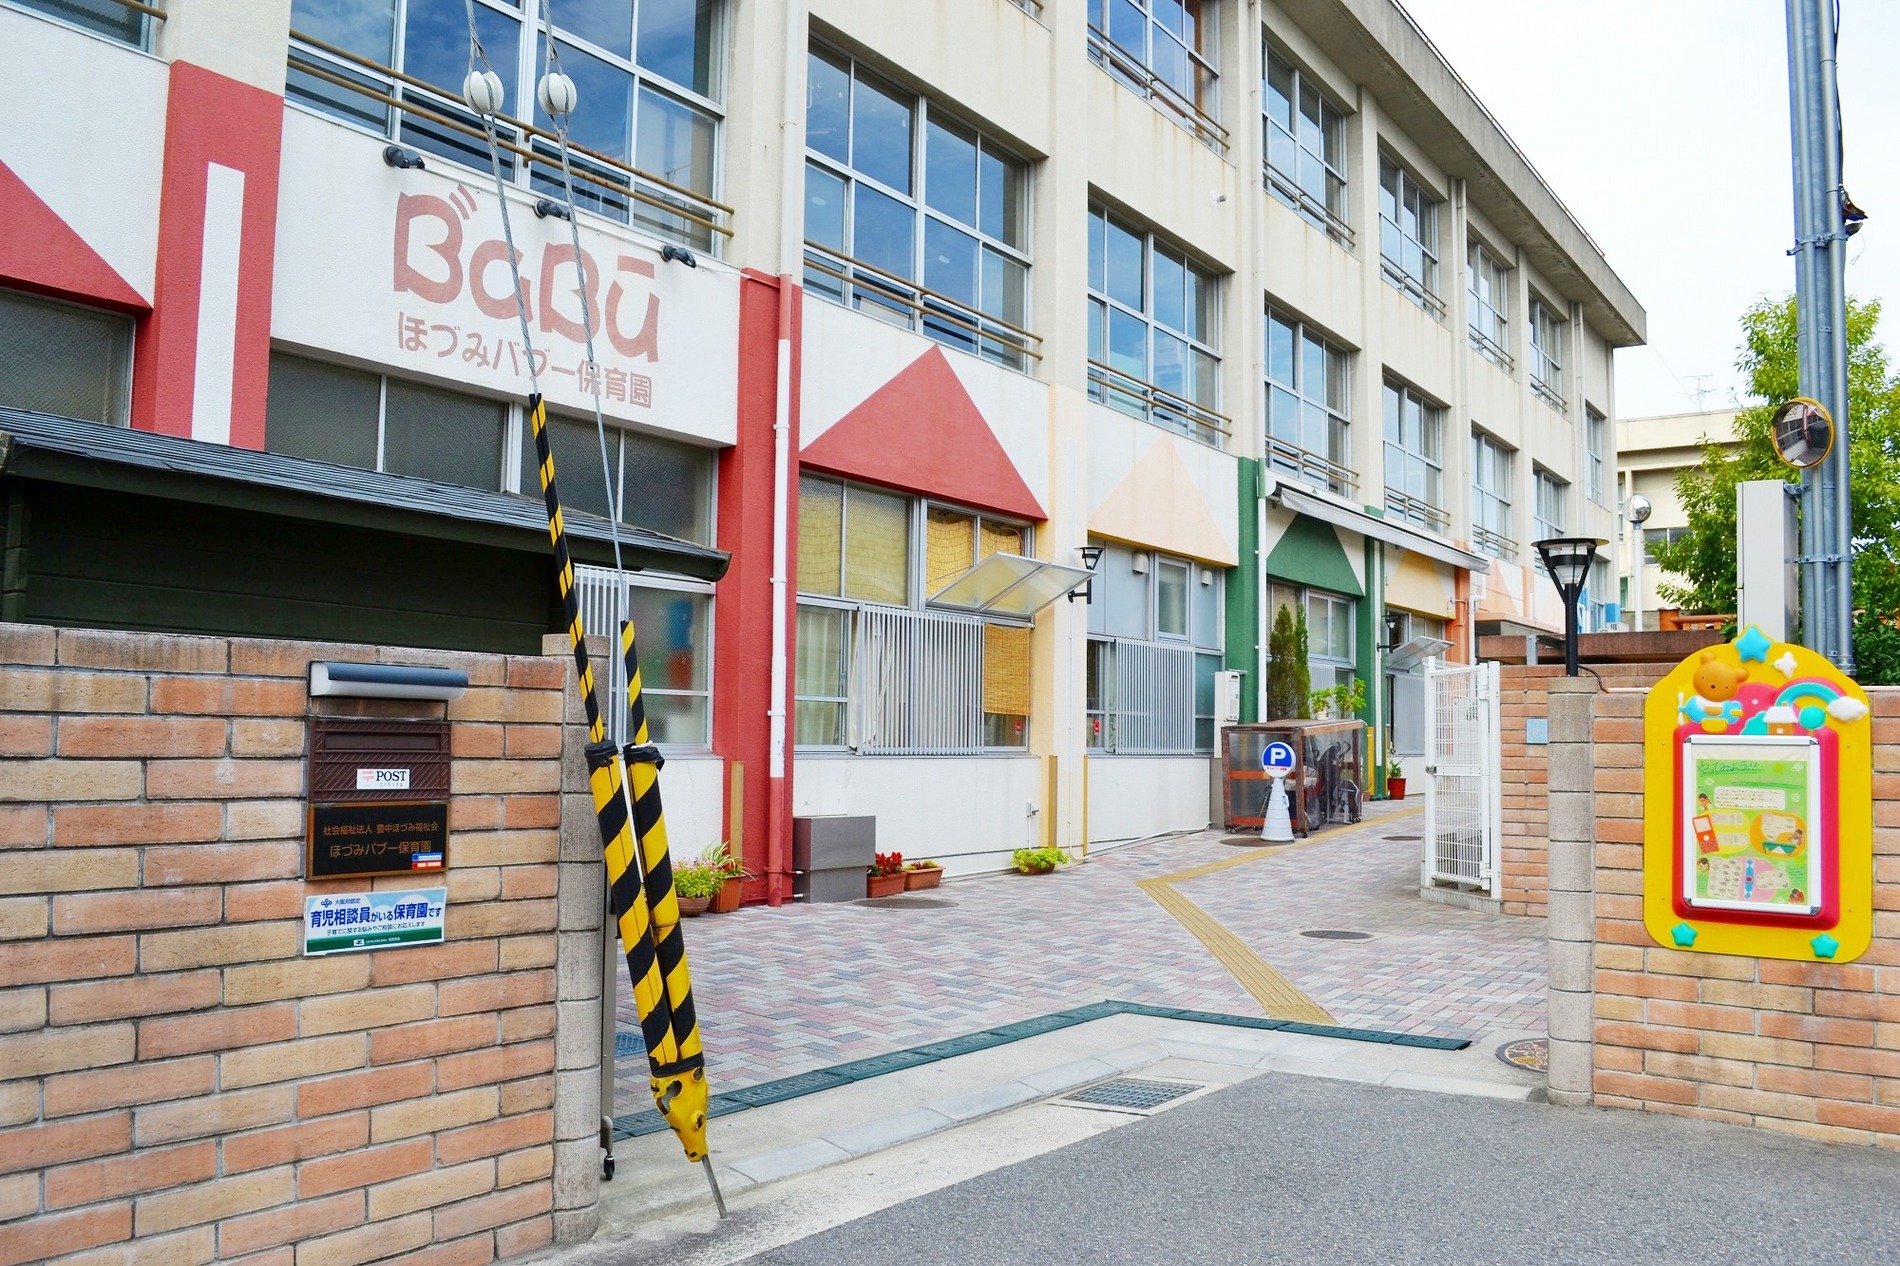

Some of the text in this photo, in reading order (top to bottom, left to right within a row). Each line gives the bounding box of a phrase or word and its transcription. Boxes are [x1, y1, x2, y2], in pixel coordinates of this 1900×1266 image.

[398, 311, 651, 409] ほづみバブー保育園
[1270, 747, 1286, 764] P
[375, 770, 406, 781] POST
[323, 824, 373, 836] 社会福祉法人
[330, 840, 432, 857] ほづみバブー保育園
[310, 902, 442, 928] 育児相談員がいる保育園です
